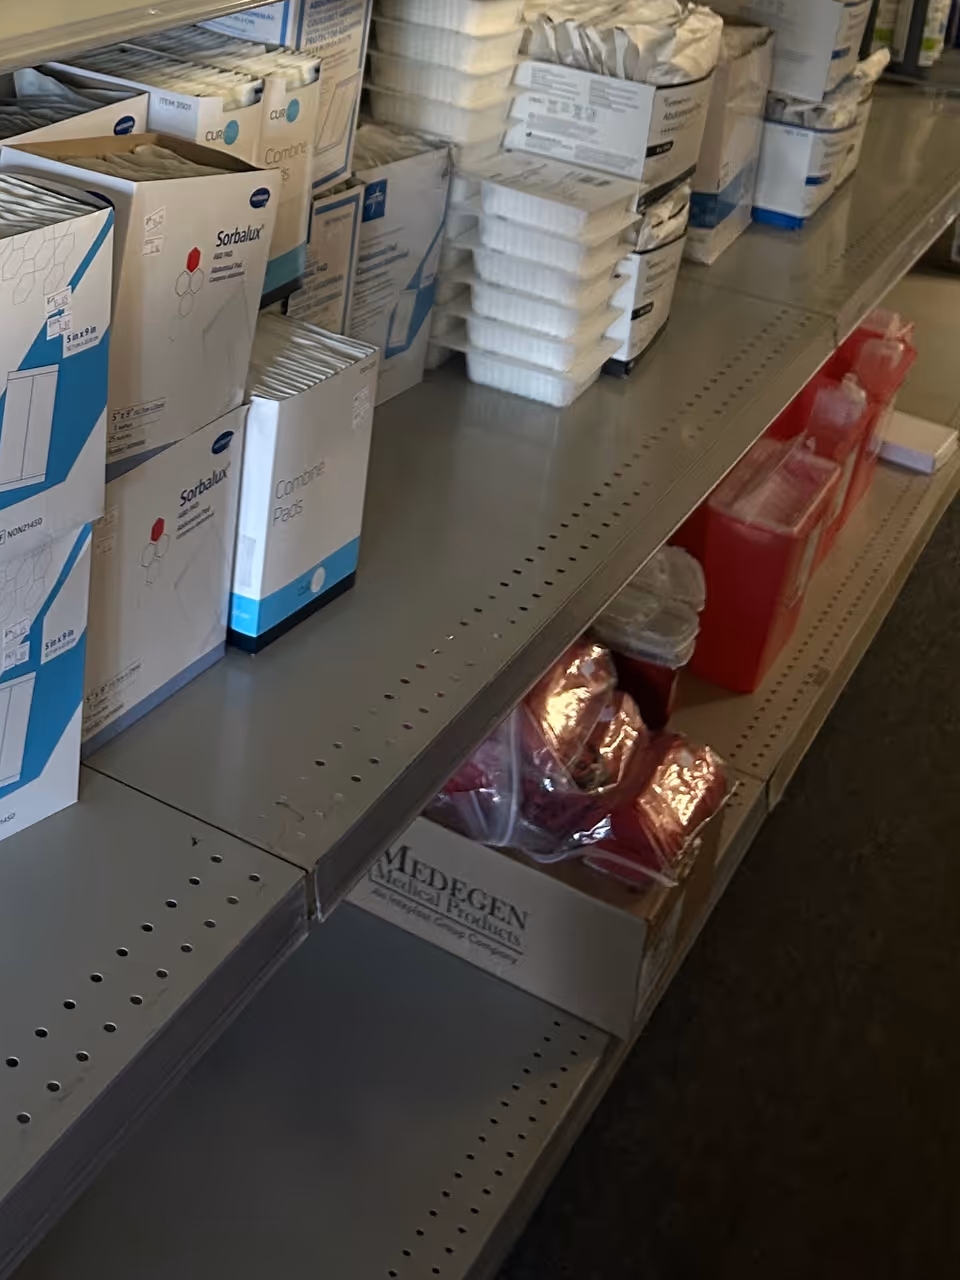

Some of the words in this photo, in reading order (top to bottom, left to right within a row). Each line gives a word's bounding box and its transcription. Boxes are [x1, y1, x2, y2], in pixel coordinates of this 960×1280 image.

[216, 227, 261, 247] Sorbalux
[180, 468, 228, 506] Sorbalux
[275, 462, 325, 499] Combine
[273, 499, 304, 525] Pads
[385, 845, 529, 930] MEDEGEN
[447, 898, 521, 946] Products
